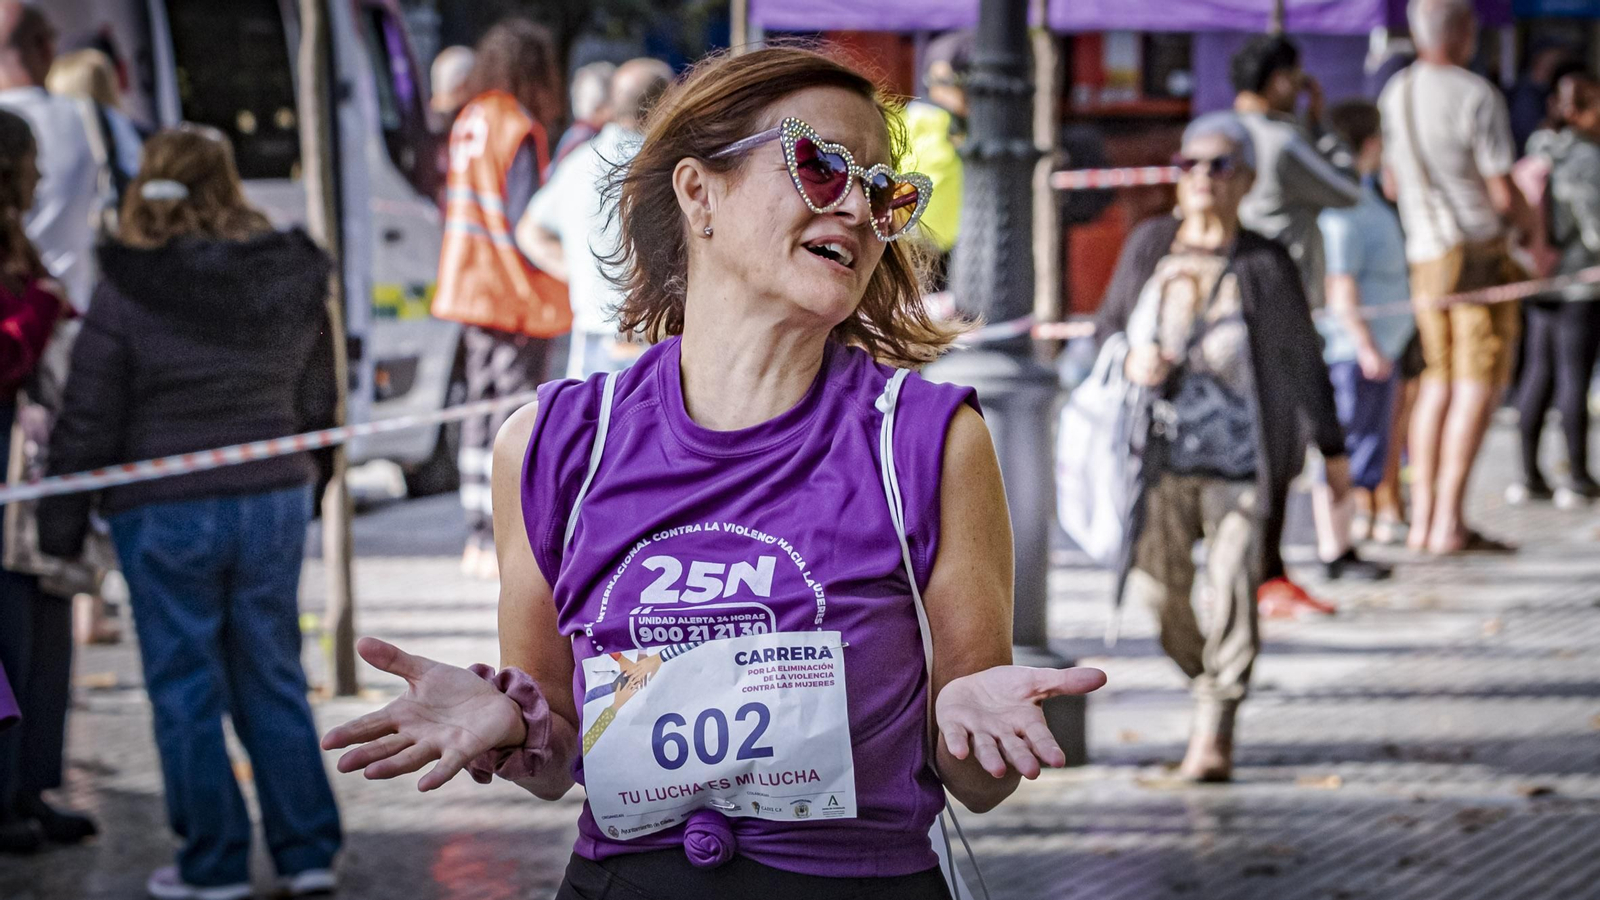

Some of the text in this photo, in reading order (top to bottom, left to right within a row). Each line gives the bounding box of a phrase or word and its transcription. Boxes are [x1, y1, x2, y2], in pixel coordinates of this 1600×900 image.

[596, 538, 651, 623] INTERNACIONAL
[652, 523, 701, 541] CONTRA
[704, 522, 719, 531] LA
[777, 537, 806, 571] HACIA
[802, 571, 815, 588] LA
[812, 583, 826, 625] UJERES
[639, 555, 776, 604] 25N
[638, 613, 766, 625] UNIDAD ALERTA 24 HORAS
[638, 621, 768, 643] 900 21 21 30
[734, 645, 833, 666] CARRERA
[748, 667, 765, 676] POR
[777, 662, 834, 672] ELIMINACIÓN
[787, 671, 835, 680] VIOLENCIA
[742, 679, 835, 693] CONTRA LAS MUJERES
[651, 702, 774, 770] 602
[618, 768, 821, 805] TU LUCHA ES MI LUCHA
